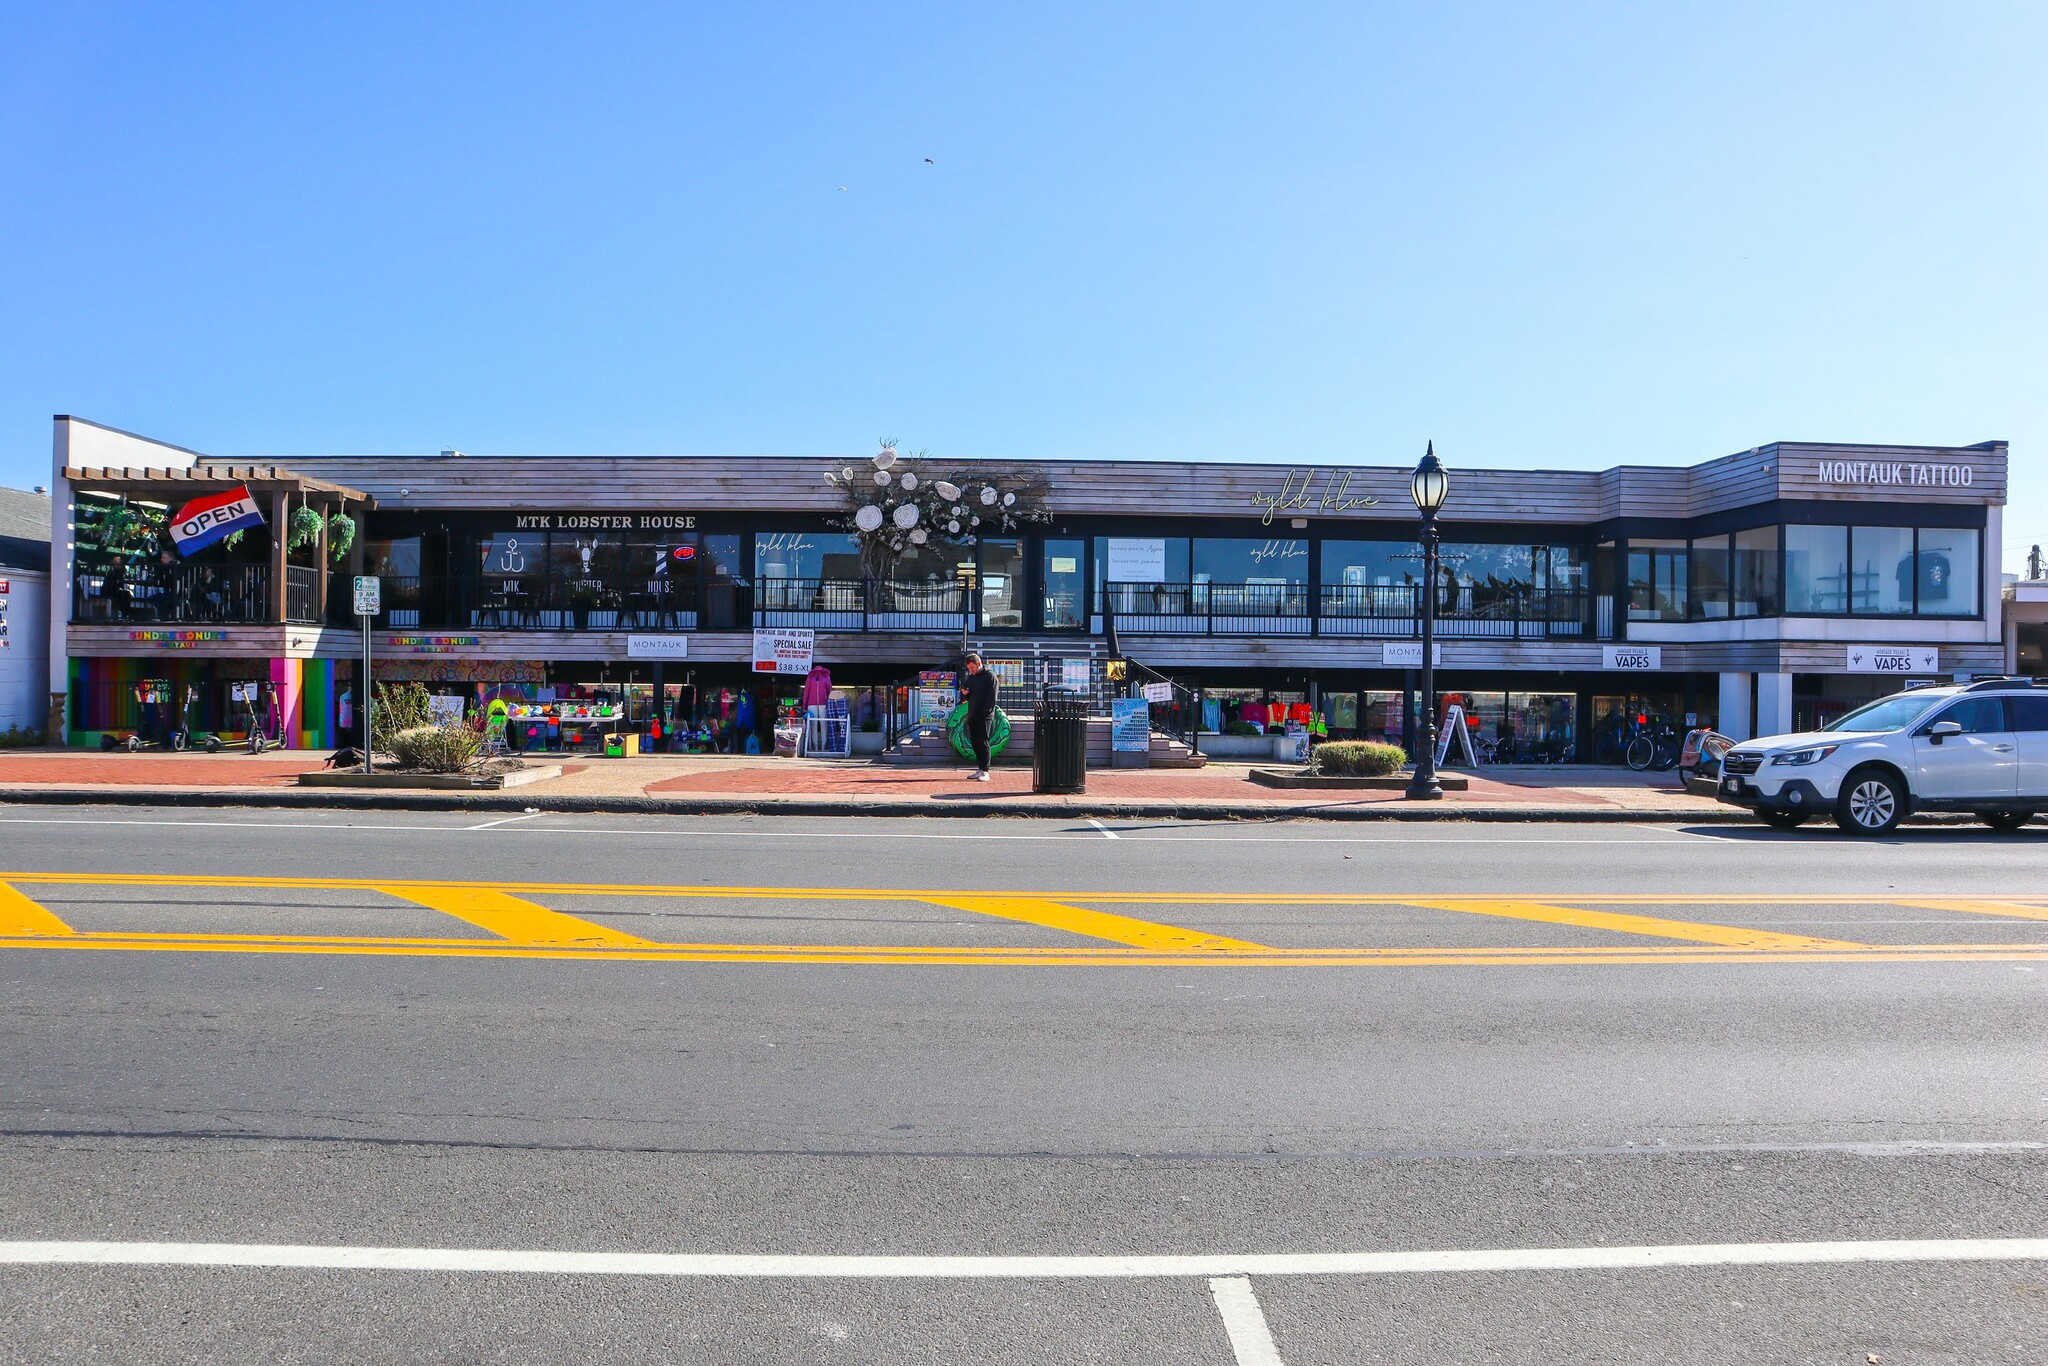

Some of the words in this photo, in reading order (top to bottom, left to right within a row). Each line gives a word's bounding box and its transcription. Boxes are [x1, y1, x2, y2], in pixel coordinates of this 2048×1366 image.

[1818, 461, 1903, 484] MONTAUK
[1908, 464, 1973, 486] TATTOO
[1250, 468, 1315, 525] wyld
[1319, 469, 1380, 514] blue
[182, 502, 246, 536] OPEN
[516, 516, 550, 528] MTK
[557, 516, 633, 529] LOBSTER
[640, 516, 696, 529] HOUSE
[756, 533, 786, 556] wyld
[787, 533, 815, 551] blue
[1250, 540, 1279, 564] wyld
[1281, 540, 1308, 559] blue
[356, 580, 361, 590] 2
[503, 580, 519, 592] MTK
[633, 640, 681, 648] MONTAUK
[773, 639, 797, 649] SPECIAL
[797, 640, 812, 650] SALE
[778, 663, 793, 671] $38
[795, 664, 810, 672] S-XL
[1615, 656, 1649, 668] VAPES
[1873, 657, 1911, 670] VAPES
